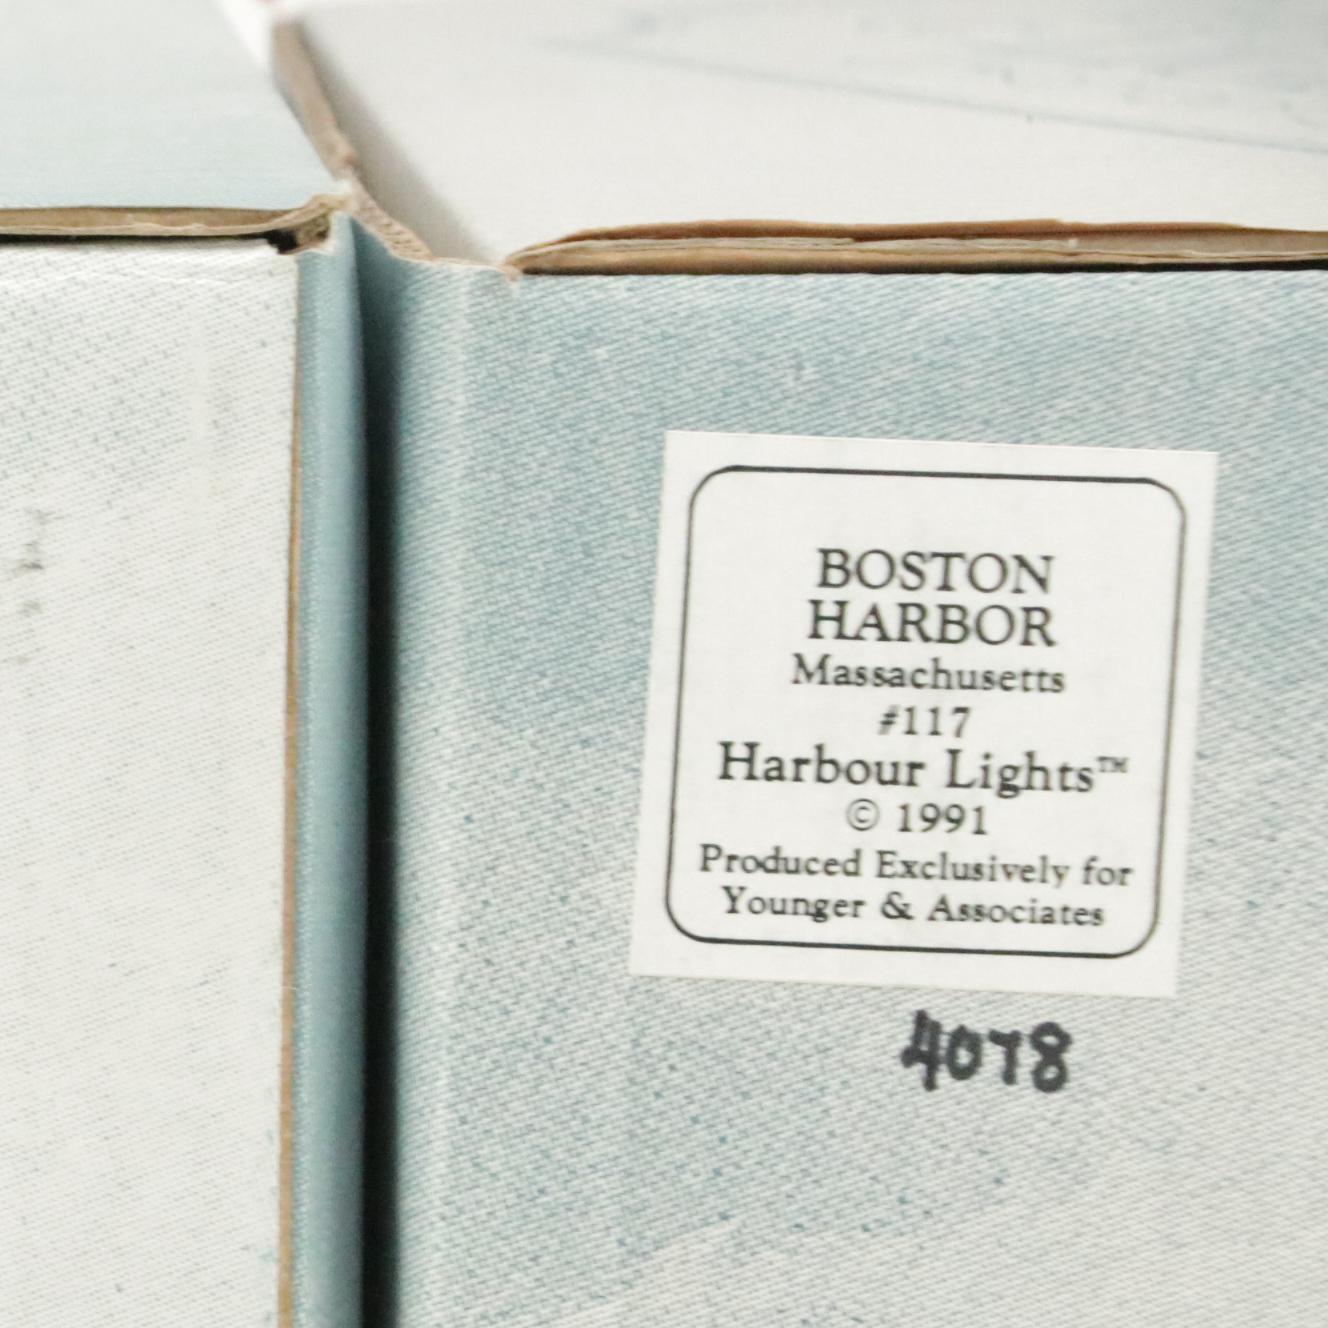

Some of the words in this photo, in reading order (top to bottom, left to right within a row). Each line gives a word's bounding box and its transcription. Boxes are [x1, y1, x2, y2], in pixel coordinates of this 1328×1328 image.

[816, 547, 1054, 595] BOSTON
[807, 598, 1057, 648] HARBOR
[791, 652, 1065, 694] Massachusetts
[879, 706, 971, 739] #117
[717, 740, 927, 788] Harbour
[848, 797, 877, 832] ©
[897, 802, 987, 836] 1991
[699, 843, 862, 878] Produced
[875, 849, 1070, 885] Exclusively
[1082, 855, 1133, 887] for
[721, 885, 866, 924] Younger
[880, 890, 915, 921] &
[926, 894, 1105, 927] Associates
[900, 1009, 1073, 1094] 4078
